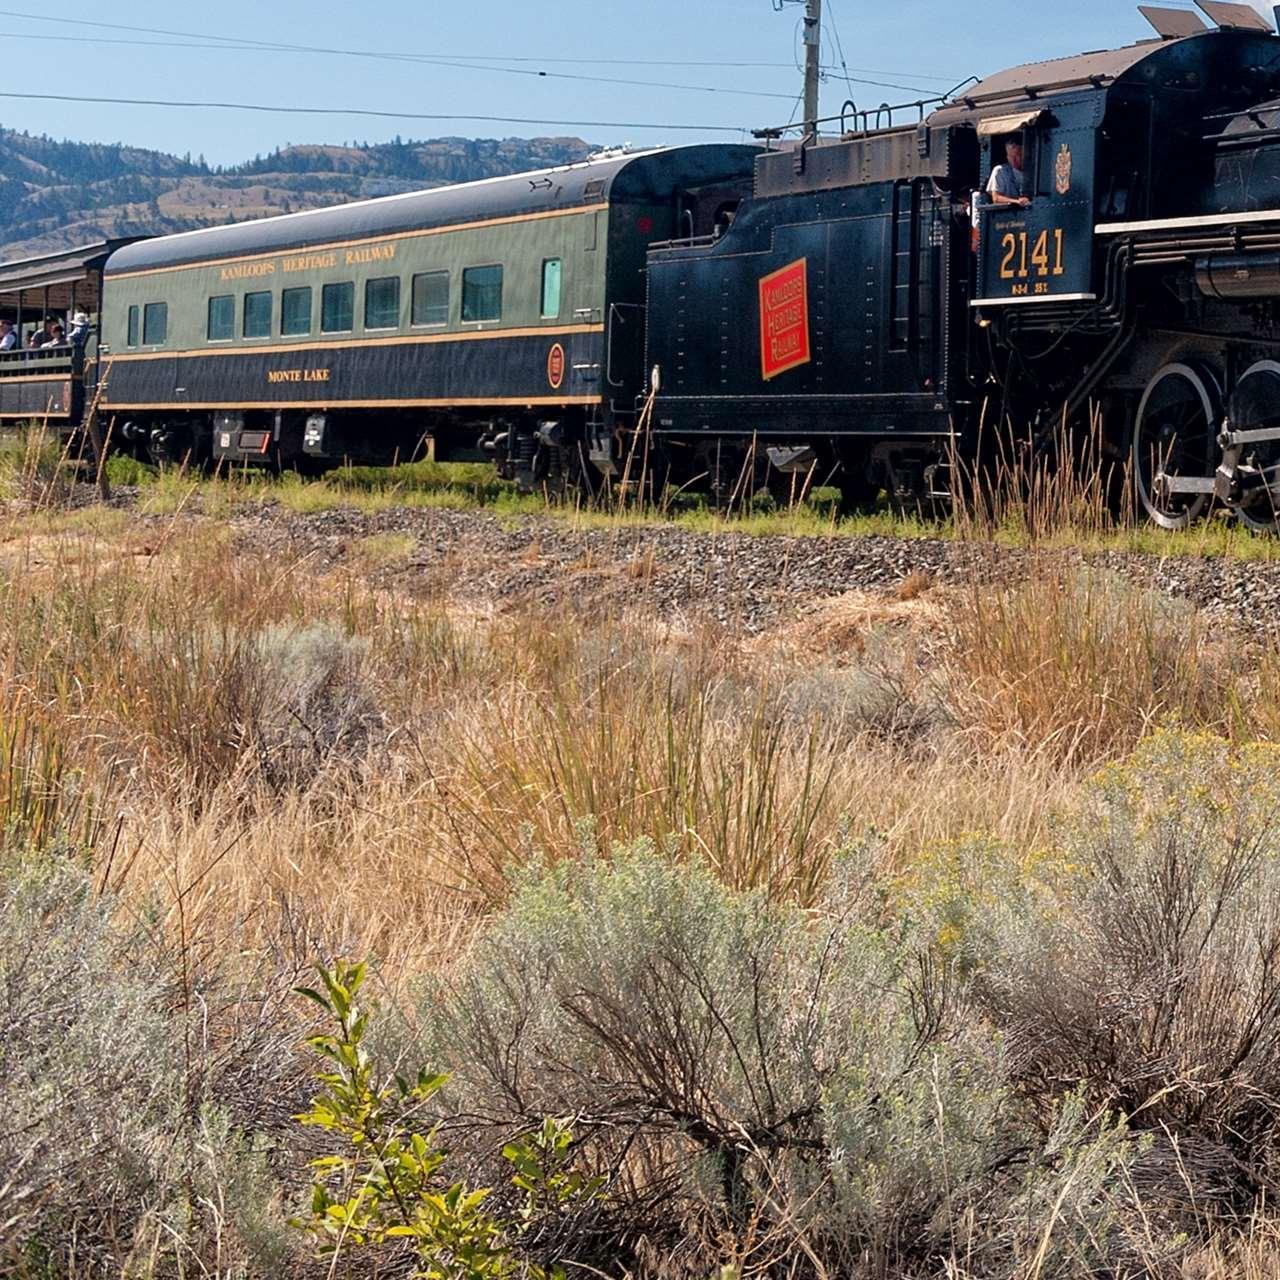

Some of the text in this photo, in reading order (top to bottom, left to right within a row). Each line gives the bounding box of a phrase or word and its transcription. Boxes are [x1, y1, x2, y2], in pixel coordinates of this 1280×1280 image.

[221, 243, 396, 281] KAMLOOPS HERITAGE RAILWAY
[1001, 228, 1064, 279] 2141
[768, 302, 803, 337] HERITAGE
[771, 333, 801, 363] RAILWAY
[267, 368, 330, 383] MONTE LAKE
